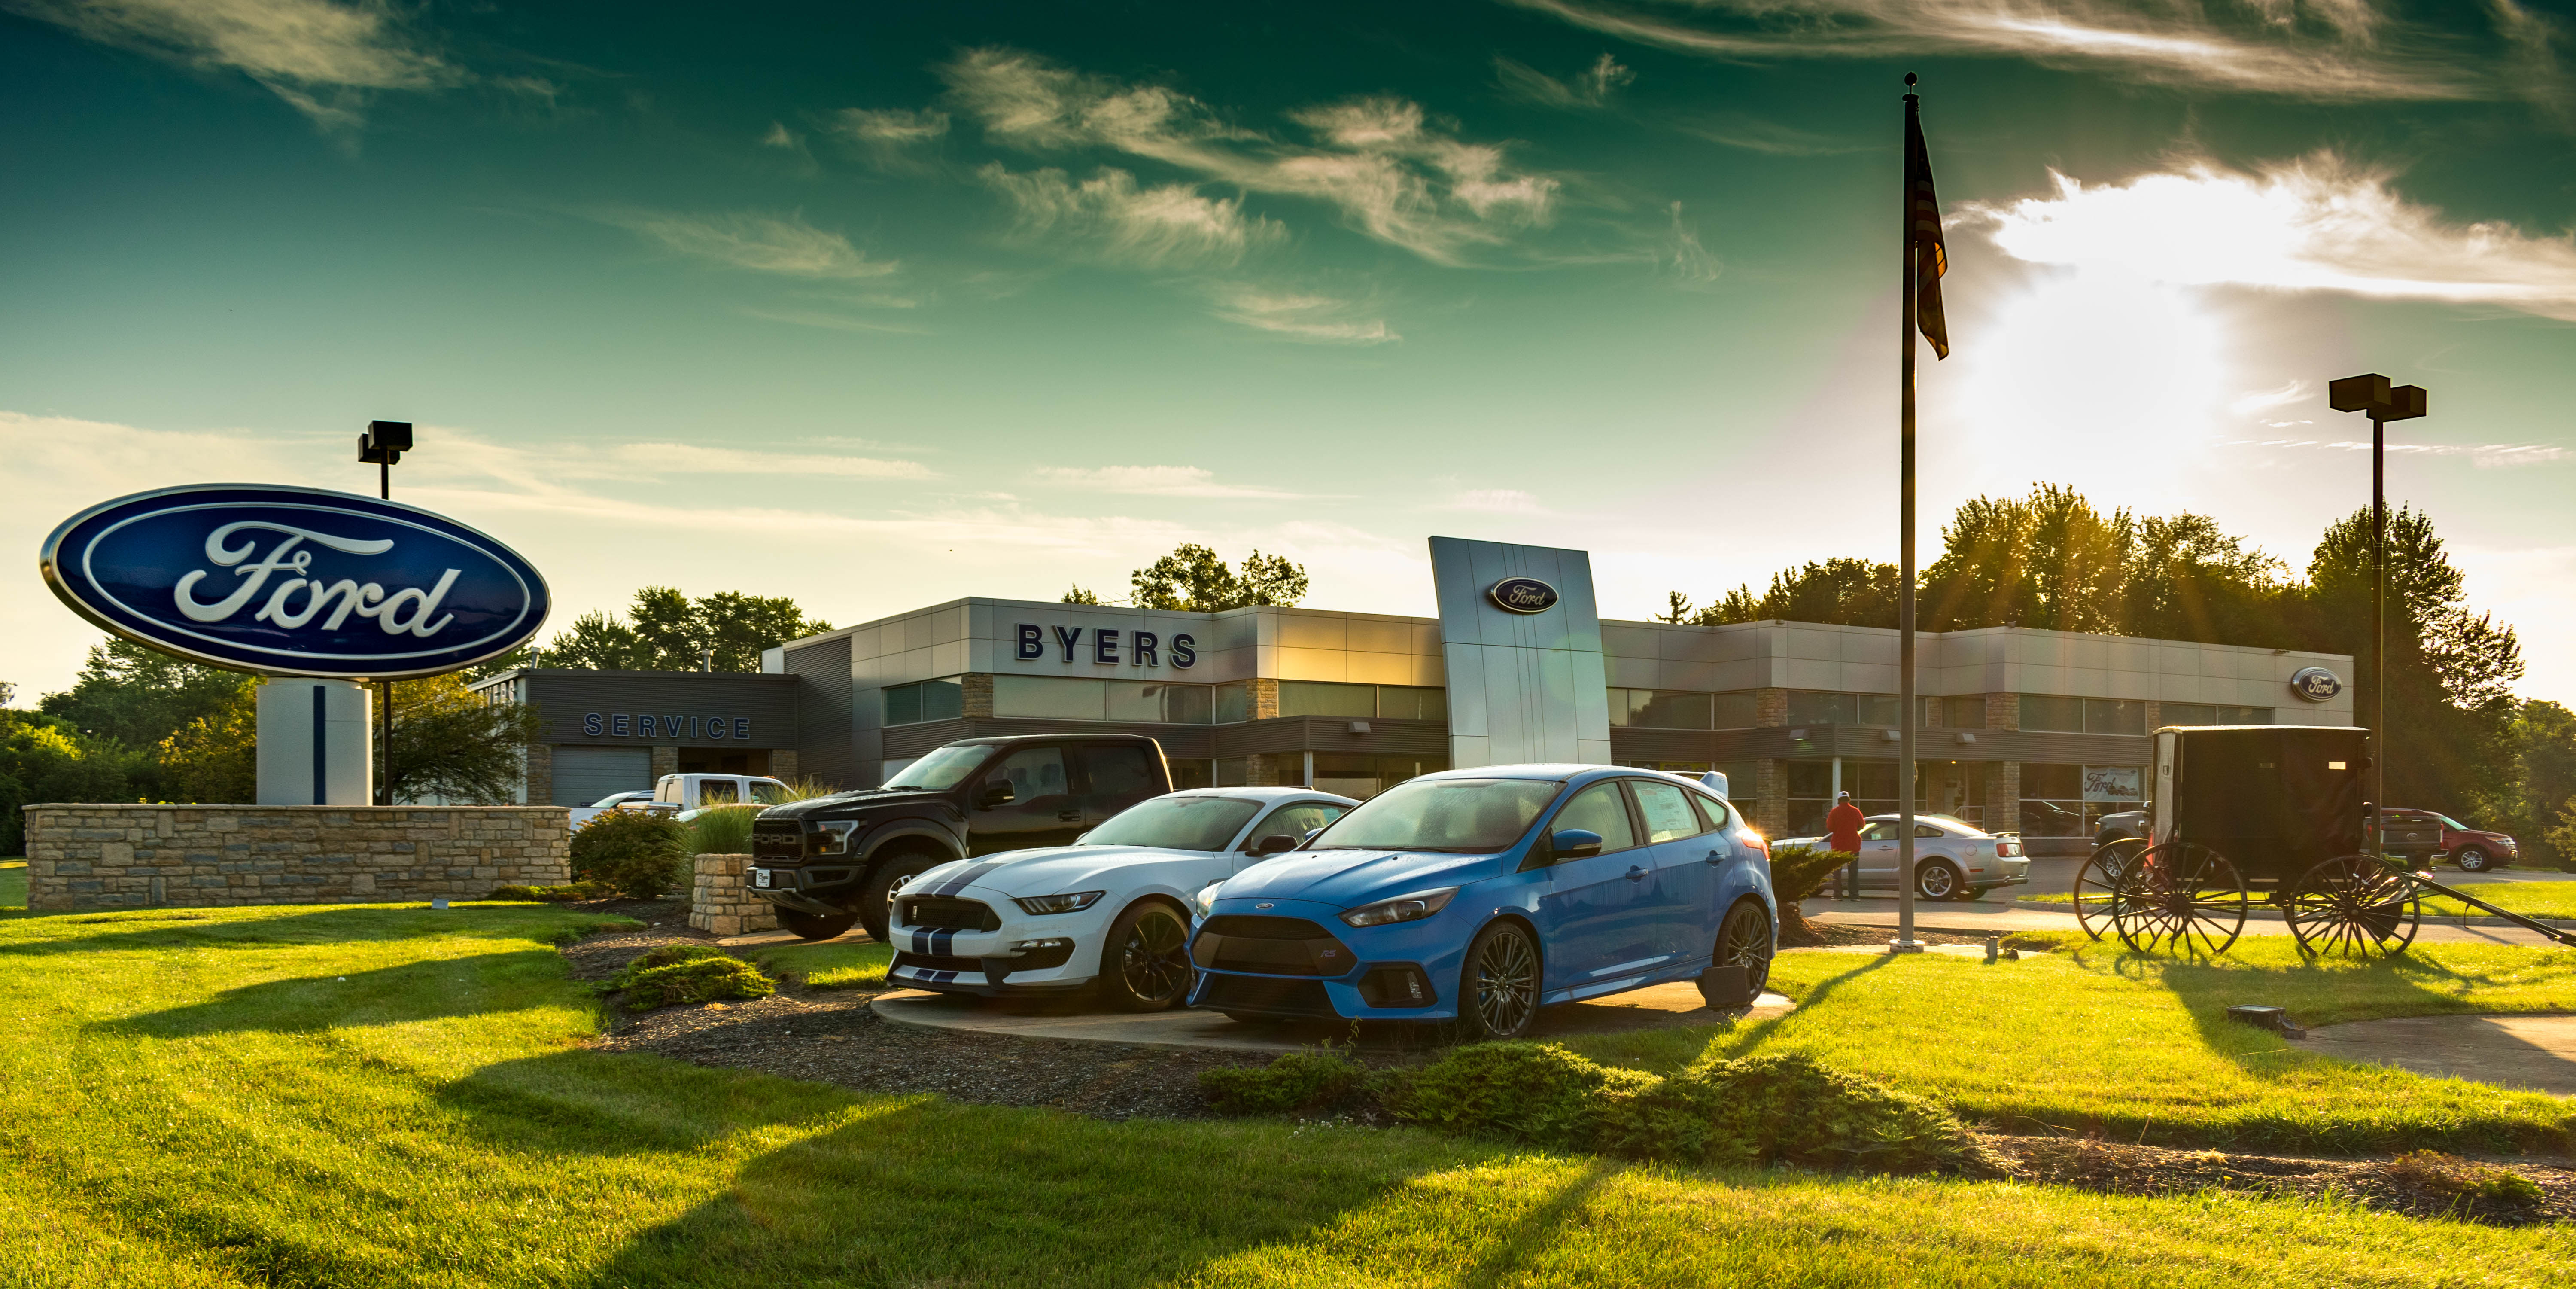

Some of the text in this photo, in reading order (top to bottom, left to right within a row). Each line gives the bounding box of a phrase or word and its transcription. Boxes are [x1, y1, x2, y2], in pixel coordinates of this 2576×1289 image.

[174, 521, 461, 638] Ford
[1509, 585, 1546, 605] Ford
[1016, 622, 1197, 669] BYERS
[2308, 675, 2334, 694] Ford
[584, 713, 750, 739] SERVICE
[753, 834, 797, 845] FORD
